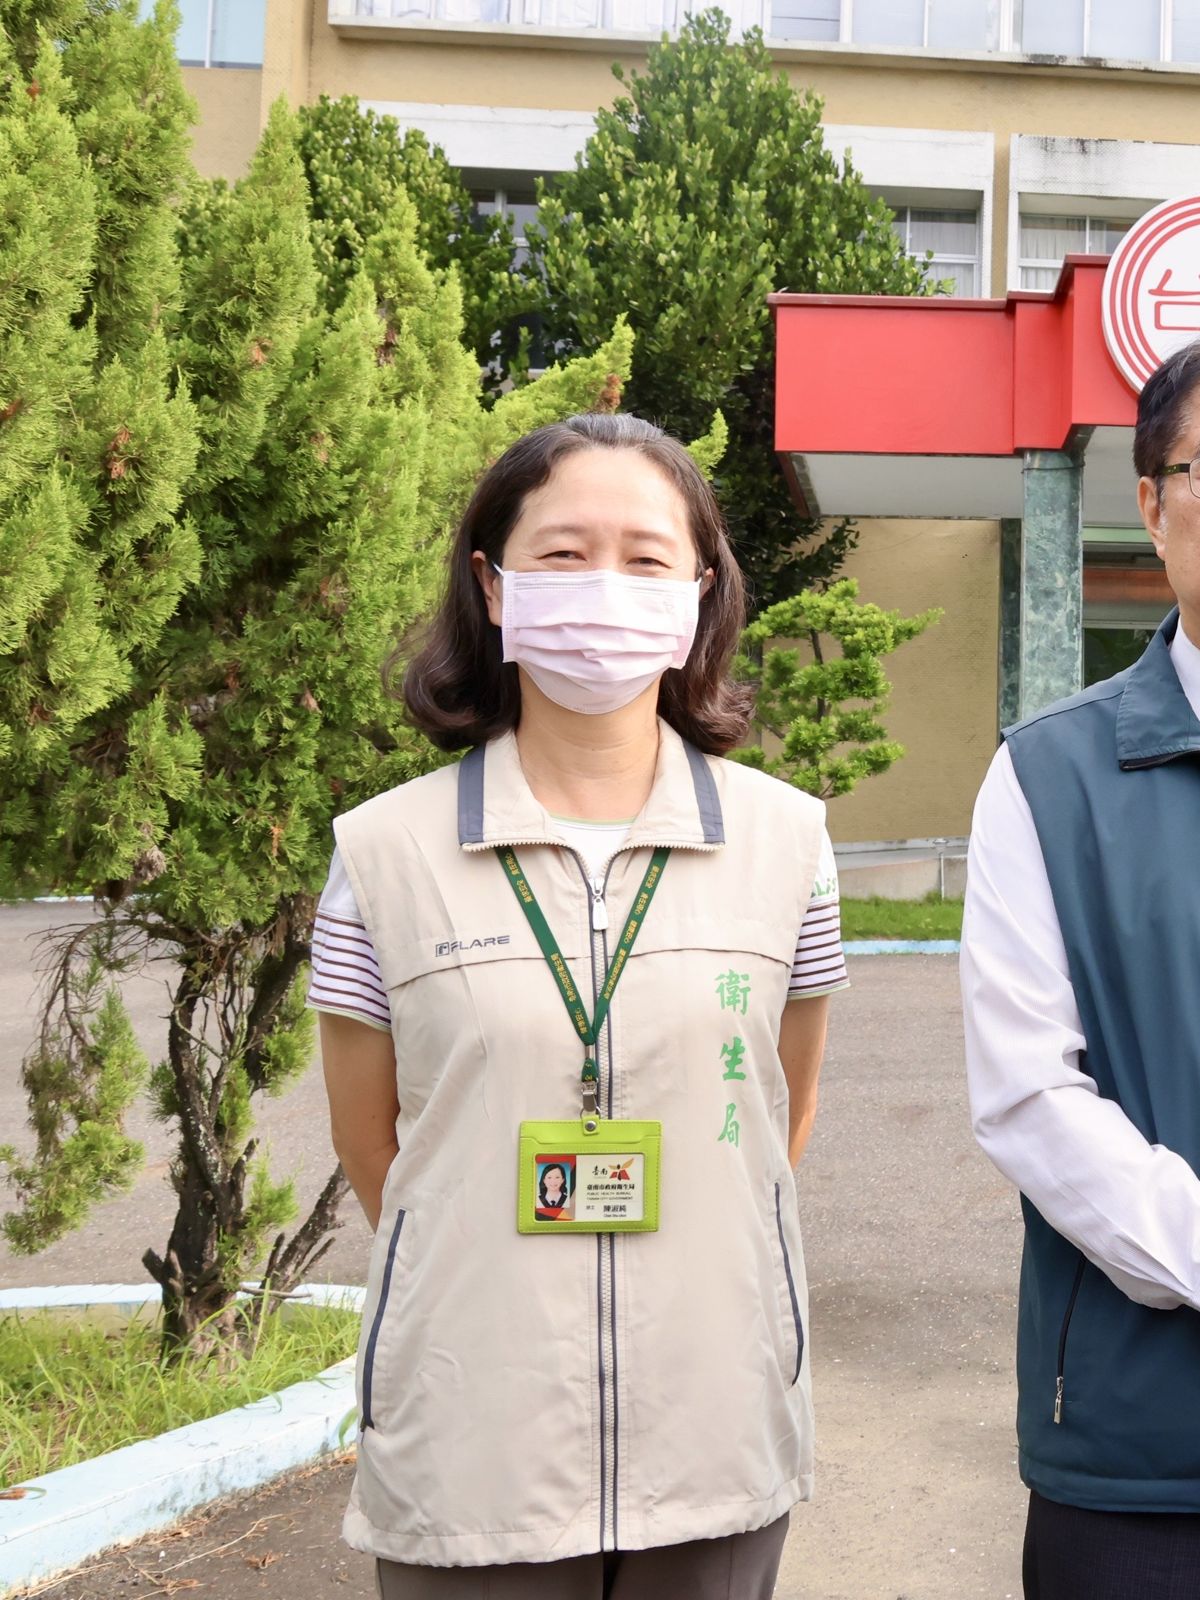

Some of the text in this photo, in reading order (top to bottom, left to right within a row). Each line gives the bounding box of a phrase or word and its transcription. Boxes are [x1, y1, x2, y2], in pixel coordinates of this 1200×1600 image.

[451, 935, 510, 952] FLARE
[714, 969, 752, 1148] 衛生局
